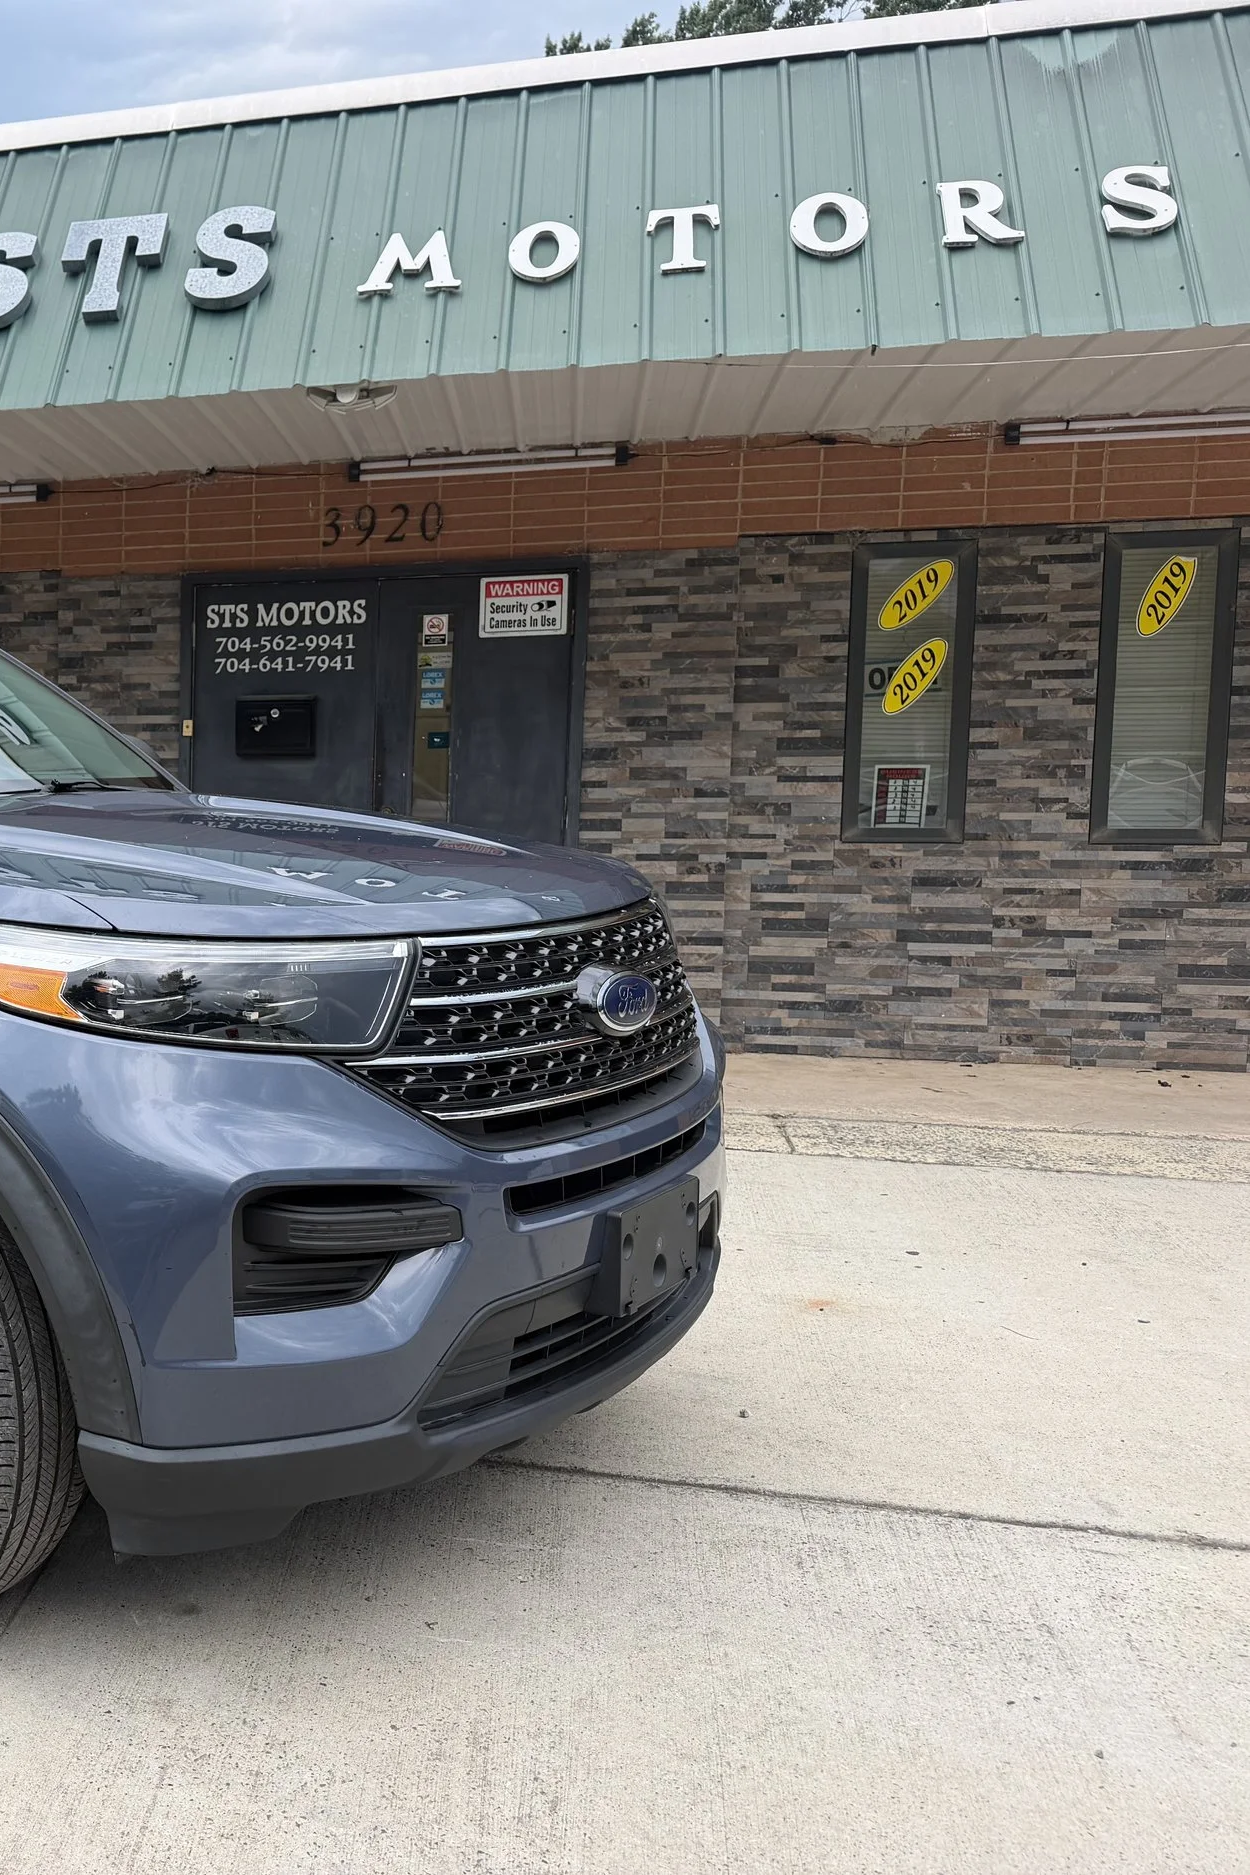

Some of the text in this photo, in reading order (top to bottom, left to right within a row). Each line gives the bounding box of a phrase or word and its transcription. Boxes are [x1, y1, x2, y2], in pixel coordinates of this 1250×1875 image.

[356, 164, 1179, 297] MOTORS
[322, 501, 444, 547] 3920
[489, 581, 559, 597] WARNING
[892, 567, 939, 624] 2019
[1146, 562, 1186, 625] 2019
[206, 599, 367, 629] STS MOTORS
[490, 601, 528, 615] Security
[490, 615, 557, 629] Cameras In Use
[215, 633, 356, 653] 704-562-9941
[214, 655, 355, 674] 704-641-7941
[893, 647, 936, 706] 2019
[618, 983, 649, 1018] Ford
